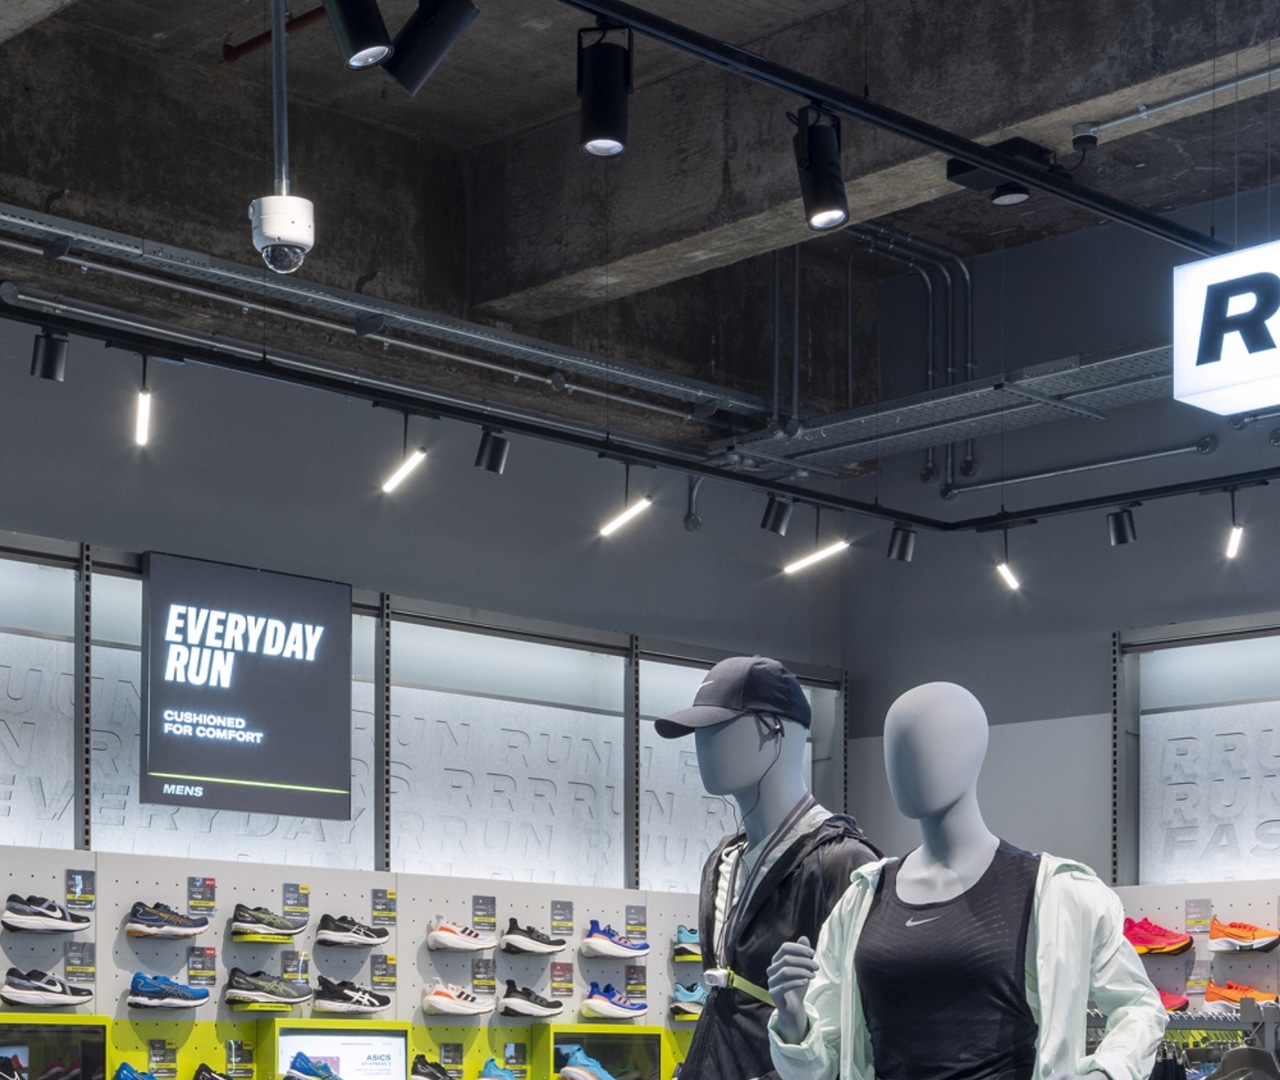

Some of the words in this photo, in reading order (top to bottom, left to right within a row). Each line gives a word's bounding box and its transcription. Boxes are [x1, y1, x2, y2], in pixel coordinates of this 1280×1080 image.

[164, 604, 325, 661] EVERYDAY
[164, 643, 234, 688] RUN
[163, 709, 246, 729] CUSHIONED
[163, 722, 192, 738] FOR
[195, 724, 263, 744] COMFORT
[162, 783, 204, 798] MENS
